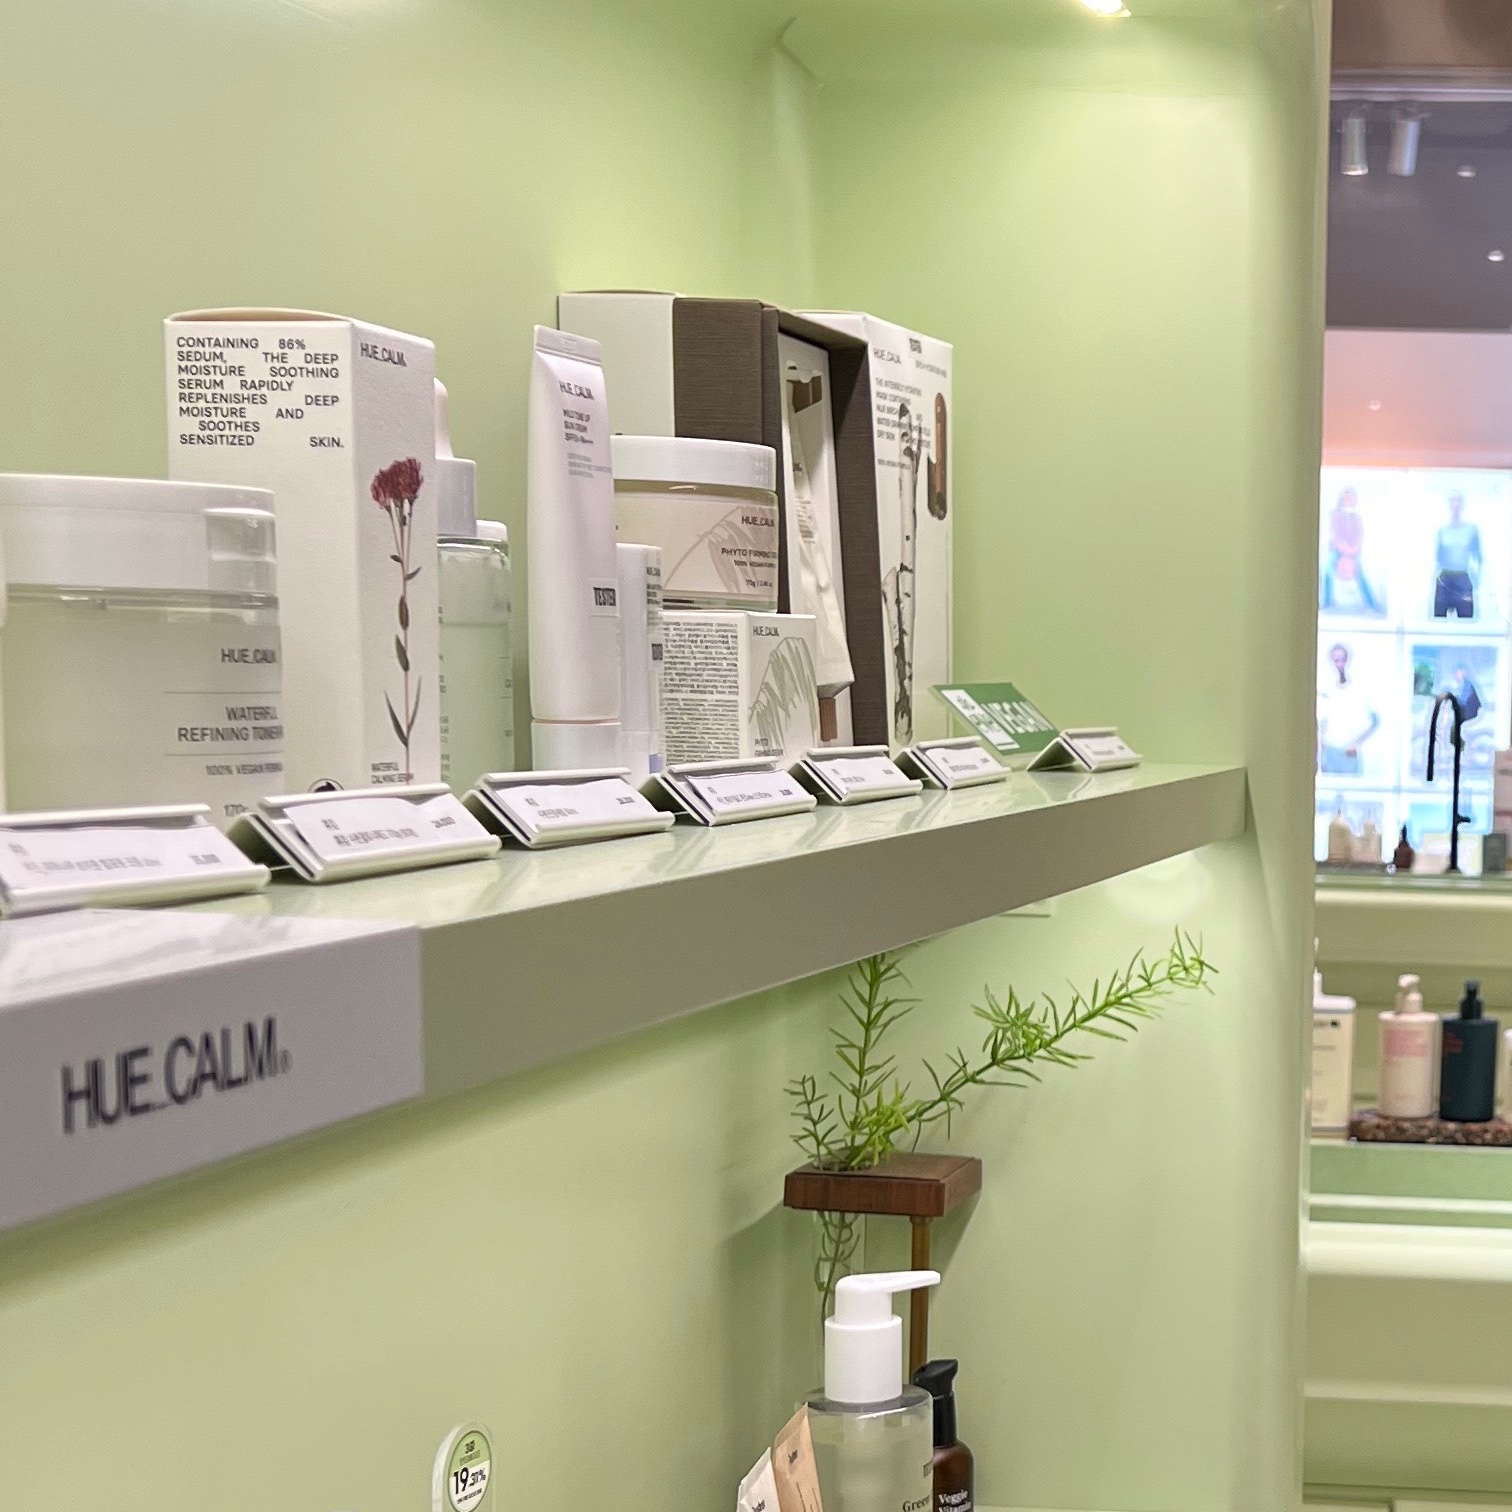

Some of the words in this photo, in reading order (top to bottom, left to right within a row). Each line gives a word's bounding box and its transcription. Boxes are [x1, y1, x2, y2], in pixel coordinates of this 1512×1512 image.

[177, 336, 259, 349] CONTAINING
[278, 338, 306, 350] 86%
[262, 352, 288, 363] THE
[304, 353, 339, 364] DEEP
[178, 365, 245, 377] MOISTURE
[269, 367, 339, 379] SOOTHING
[178, 379, 224, 390] SERUM
[240, 380, 294, 391] RAPIDLY
[179, 392, 268, 405] REPLENISHES
[305, 395, 339, 406] DEEP
[179, 407, 246, 418] MOISTURE
[275, 408, 304, 419] AND
[198, 420, 260, 432] SOOTHES
[180, 434, 255, 446] SENSITIZED
[310, 436, 345, 448] SKIN.
[721, 548, 747, 557] PHYTO
[979, 701, 1053, 734] VEGAN
[177, 726, 250, 742] REFINING
[938, 1489, 969, 1505] Veggie
